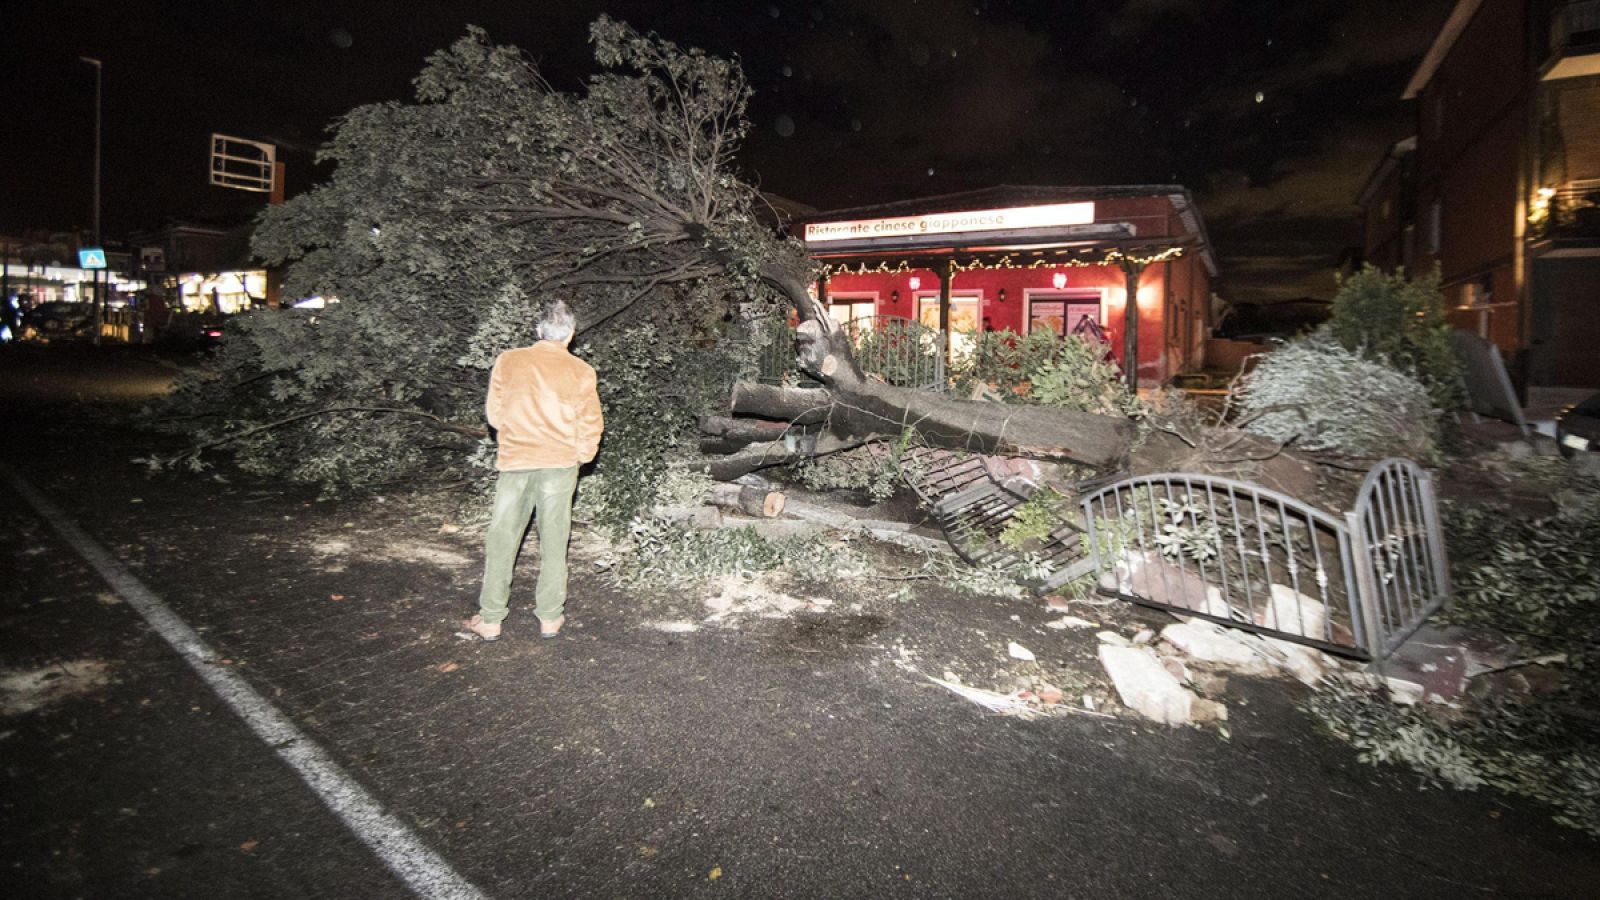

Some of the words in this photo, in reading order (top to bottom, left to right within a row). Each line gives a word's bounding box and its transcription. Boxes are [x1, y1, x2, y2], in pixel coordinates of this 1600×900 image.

[807, 223, 870, 236] Ristorante
[874, 220, 915, 232] cinese
[919, 214, 1004, 232] giapponese
